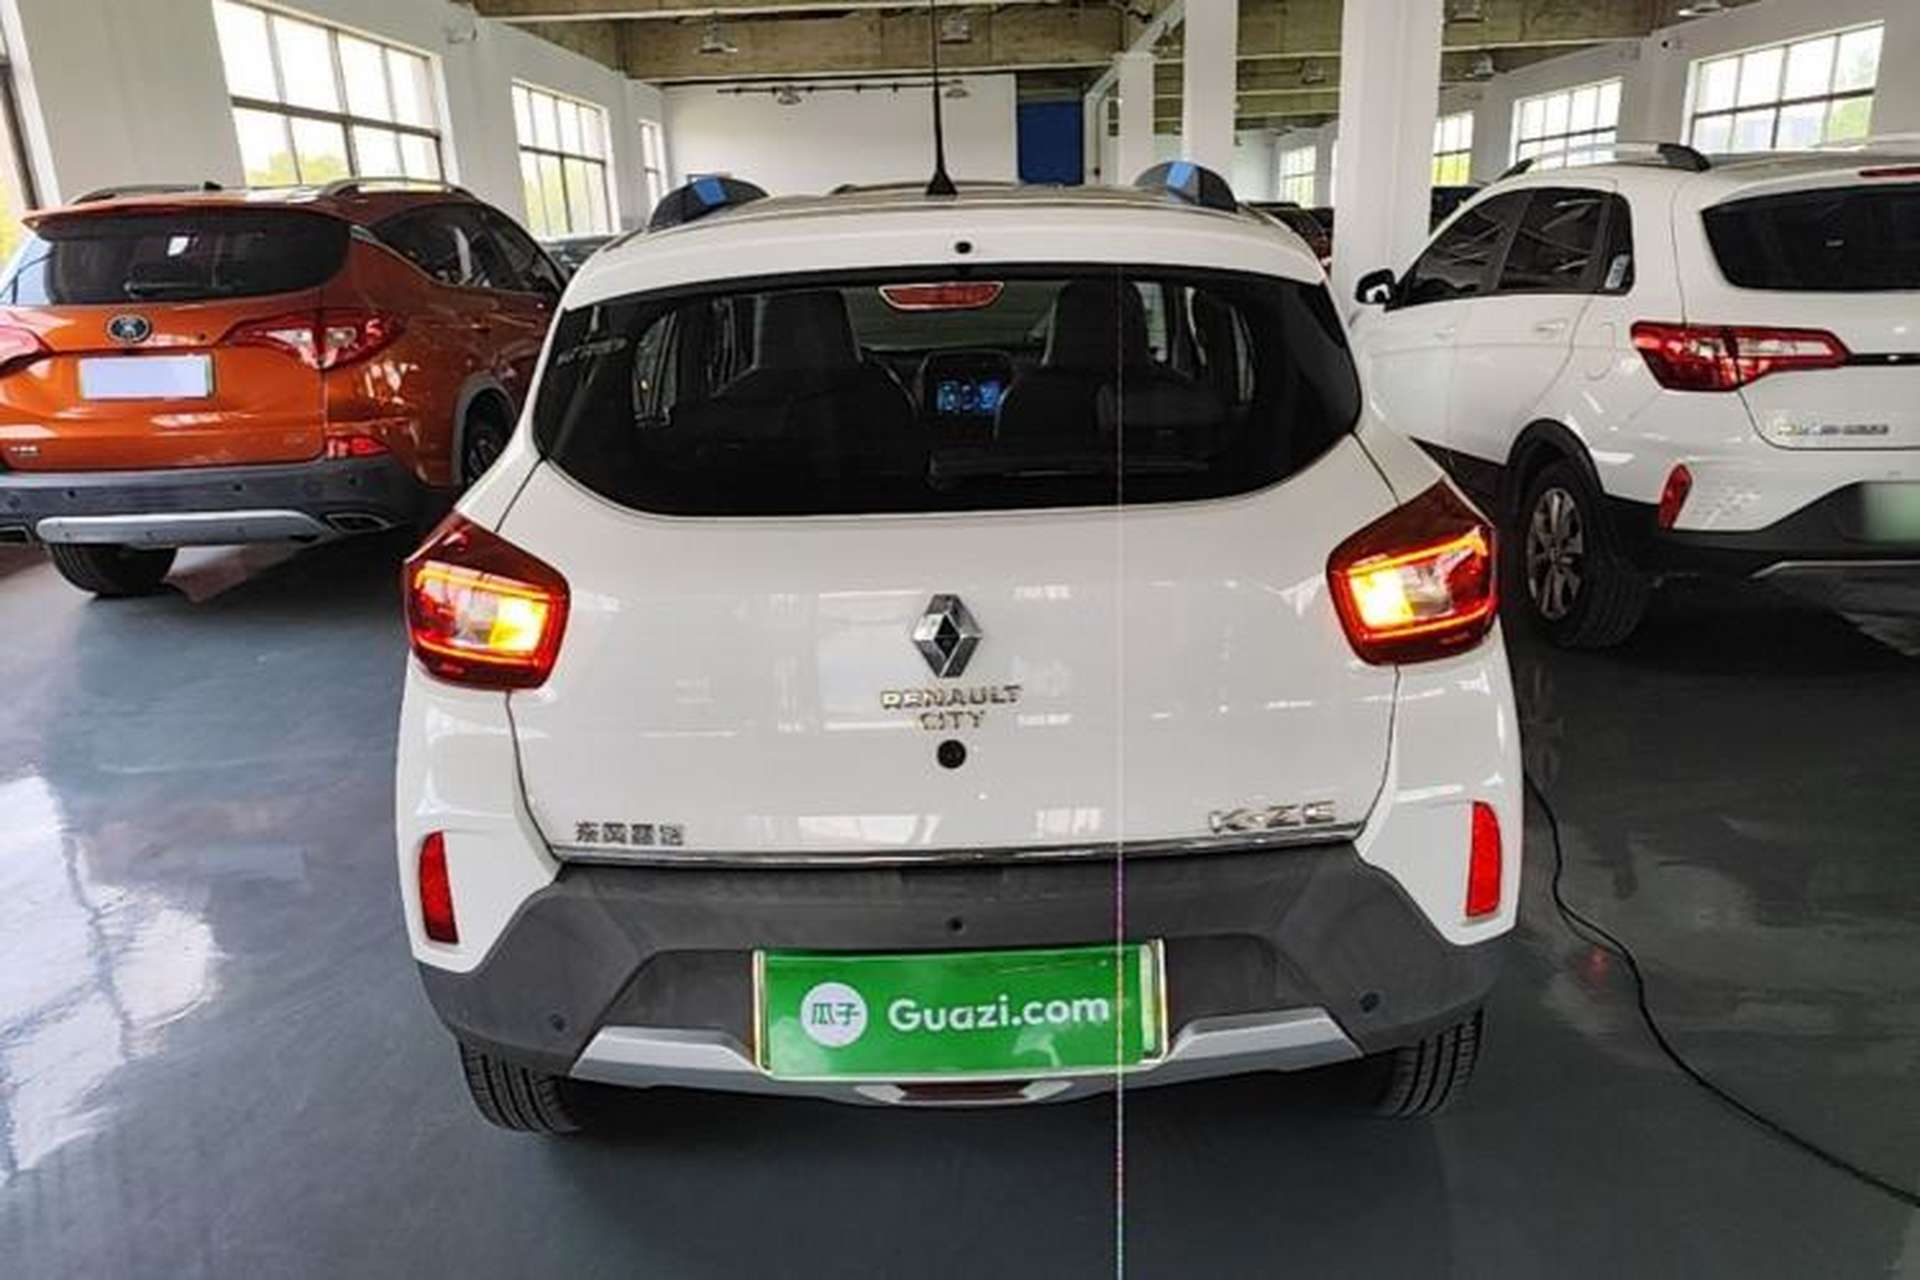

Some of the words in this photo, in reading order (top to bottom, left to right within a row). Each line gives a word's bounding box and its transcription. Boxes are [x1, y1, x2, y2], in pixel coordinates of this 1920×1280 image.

[881, 685, 1021, 709] RENAULT
[920, 711, 985, 730] CITY
[811, 1001, 861, 1026] 瓜子
[888, 995, 1110, 1031] Guazi.com
